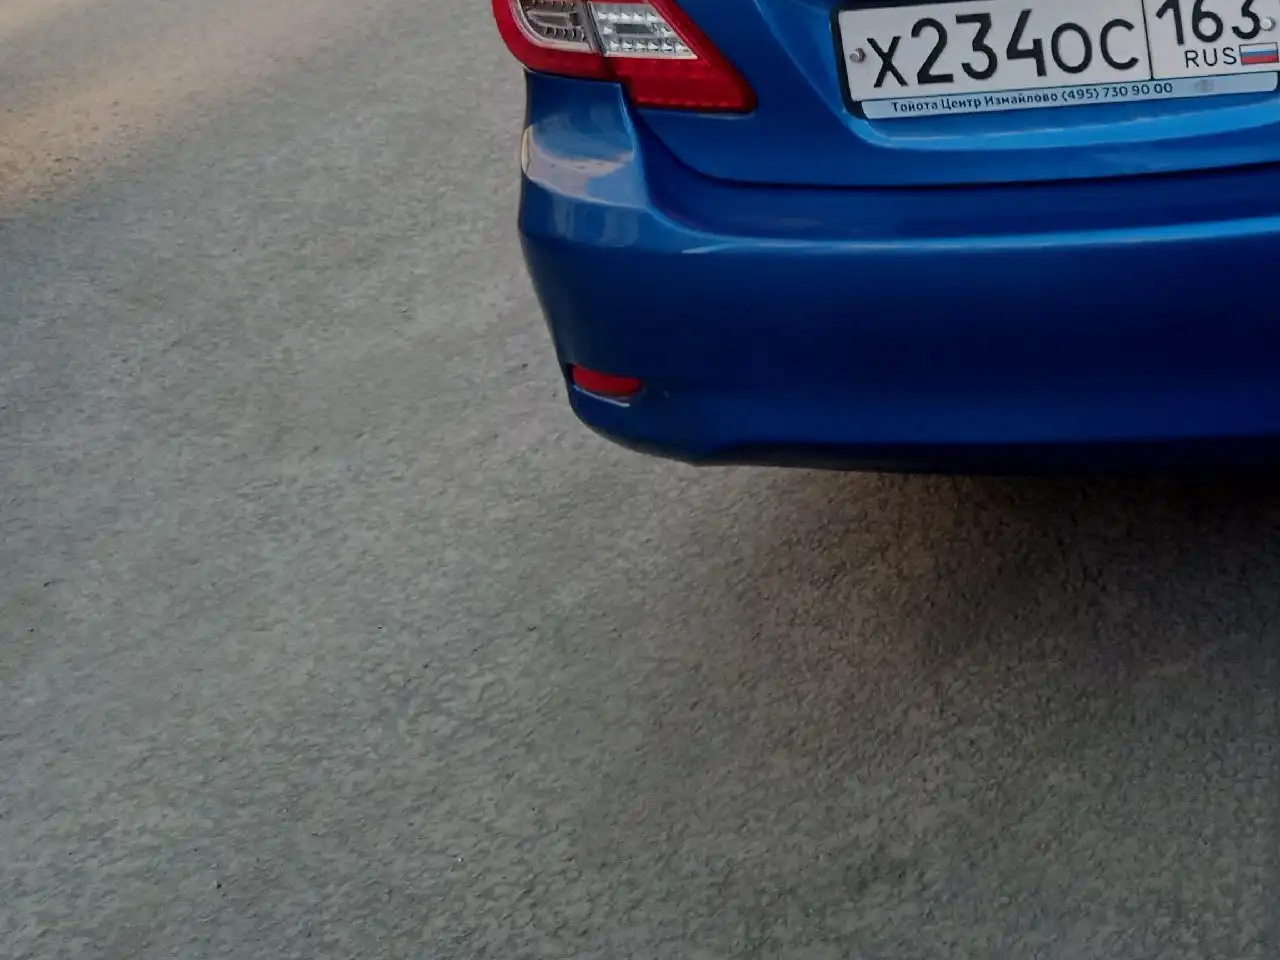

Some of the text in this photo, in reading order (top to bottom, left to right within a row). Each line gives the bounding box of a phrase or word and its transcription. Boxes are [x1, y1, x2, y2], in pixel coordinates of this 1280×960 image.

[1184, 47, 1237, 68] RUS
[891, 82, 1173, 113] Тойота Центр Измайлово (495) 730 90 00
